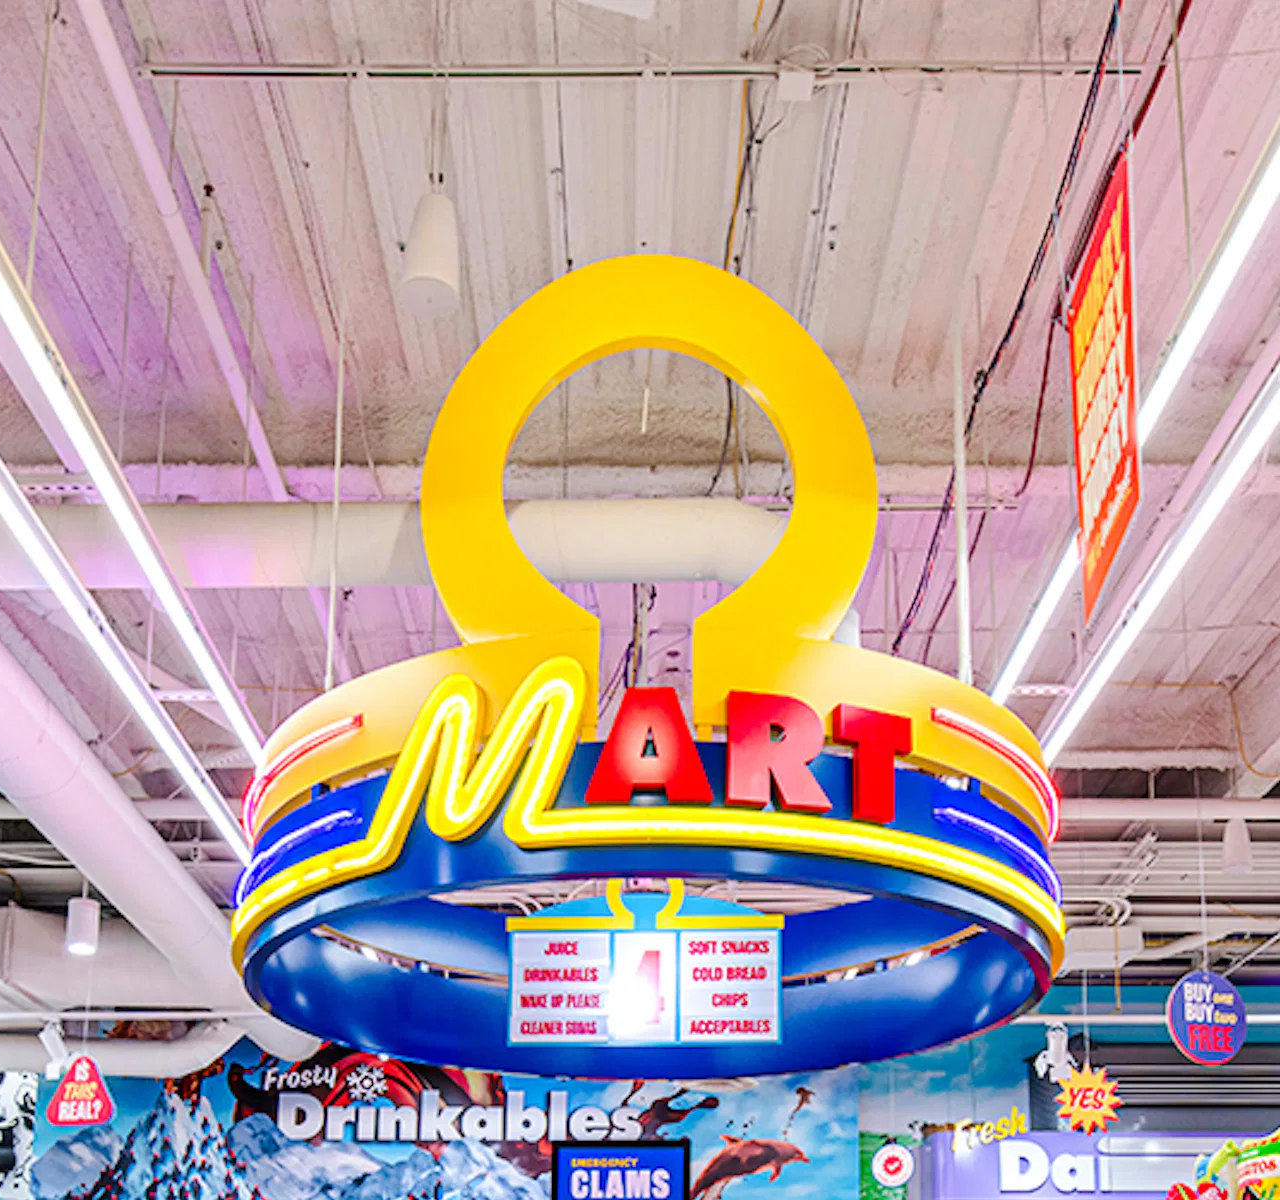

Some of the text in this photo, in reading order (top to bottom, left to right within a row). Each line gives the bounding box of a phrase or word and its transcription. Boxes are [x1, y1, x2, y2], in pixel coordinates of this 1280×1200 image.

[544, 941, 578, 956] JUICE
[689, 941, 770, 955] SOFT SNACKS
[524, 968, 598, 982] DRINKABLES
[692, 967, 767, 982] COLD BREAD
[711, 993, 748, 1007] CHIPS
[1184, 982, 1213, 1003] BUY
[1184, 1002, 1215, 1023] BUY
[690, 1020, 770, 1034] ACCEPTABLES
[1187, 1023, 1234, 1052] FREE
[75, 1060, 91, 1081] IS
[263, 1065, 338, 1091] Frosty
[63, 1082, 98, 1100] THIS
[1068, 1088, 1105, 1110] YES
[58, 1099, 102, 1121] REAL?
[276, 1091, 645, 1141] Drinkables
[952, 1106, 1029, 1152] Fresh
[571, 1168, 671, 1199] CLAMS
